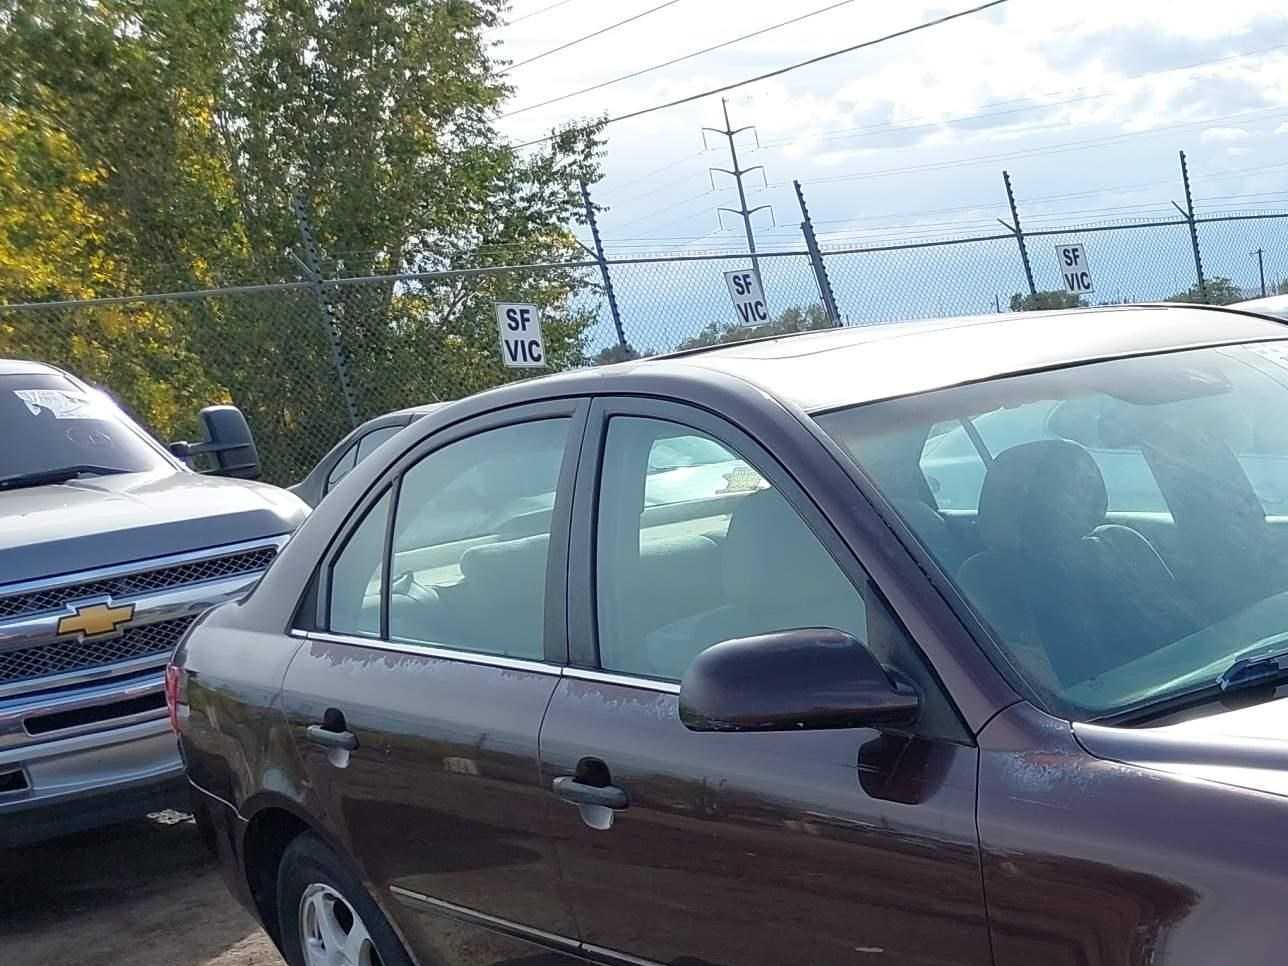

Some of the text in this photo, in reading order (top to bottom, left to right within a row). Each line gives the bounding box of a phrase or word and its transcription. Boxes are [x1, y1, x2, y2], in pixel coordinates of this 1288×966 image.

[1063, 247, 1080, 266] SF
[733, 274, 752, 295] SF
[1064, 271, 1091, 291] VIC
[506, 308, 531, 331] SF
[736, 300, 767, 322] VIC
[504, 339, 542, 362] VIC
